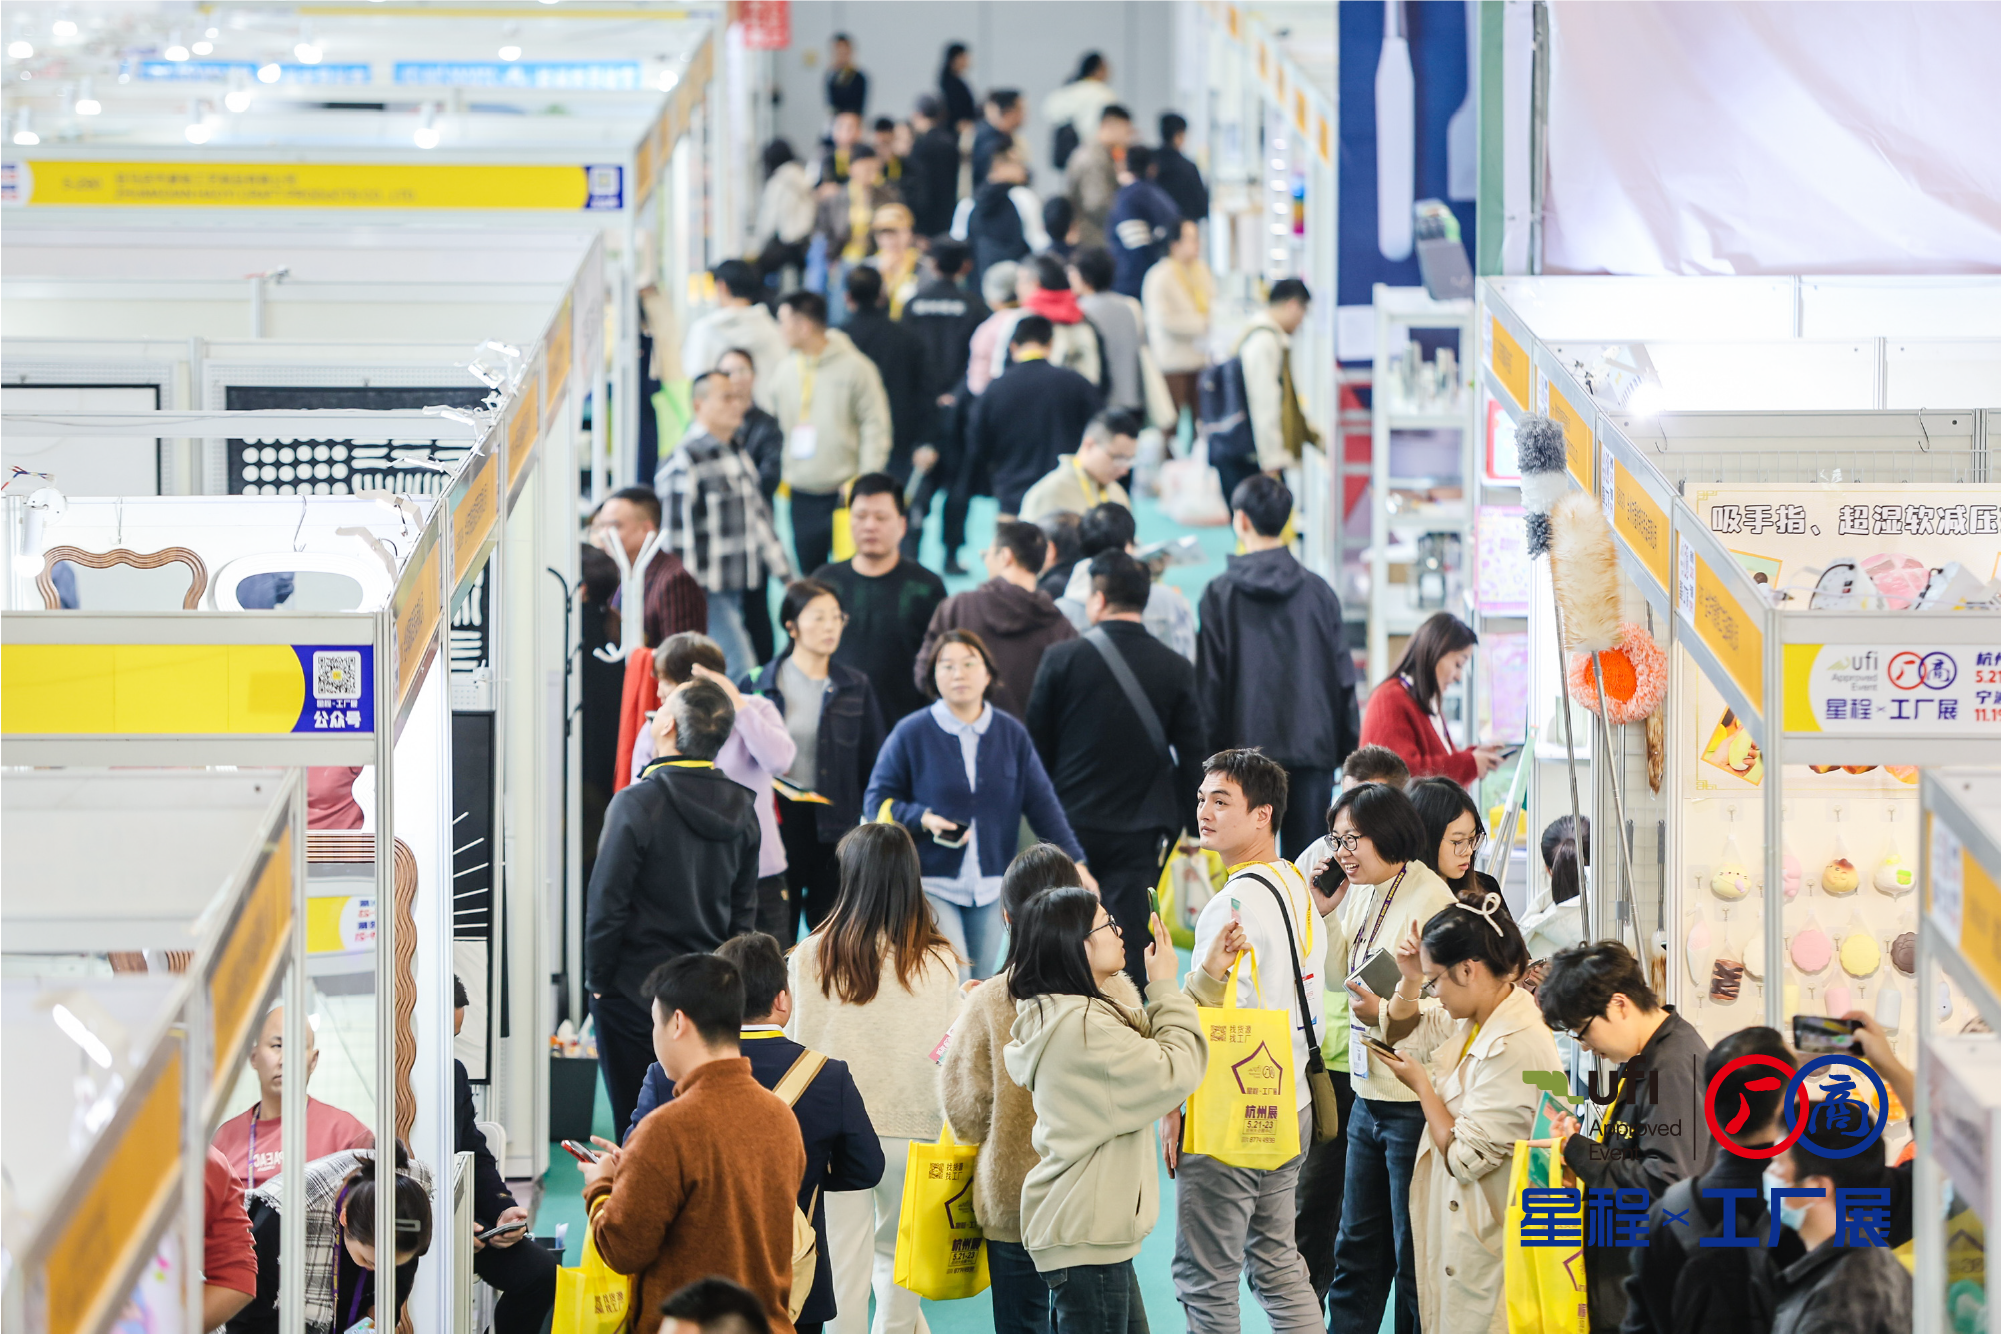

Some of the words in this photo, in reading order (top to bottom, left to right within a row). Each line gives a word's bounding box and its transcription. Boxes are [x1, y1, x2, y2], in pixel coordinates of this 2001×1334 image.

[1852, 651, 1878, 671] ufi
[1831, 673, 1878, 682] Approved
[1851, 683, 1878, 692] Event
[313, 710, 361, 729] 公众号
[1245, 1105, 1278, 1119] 杭州展
[1247, 1121, 1274, 1129] 5.21-23
[952, 1252, 976, 1261] 5.21-23
